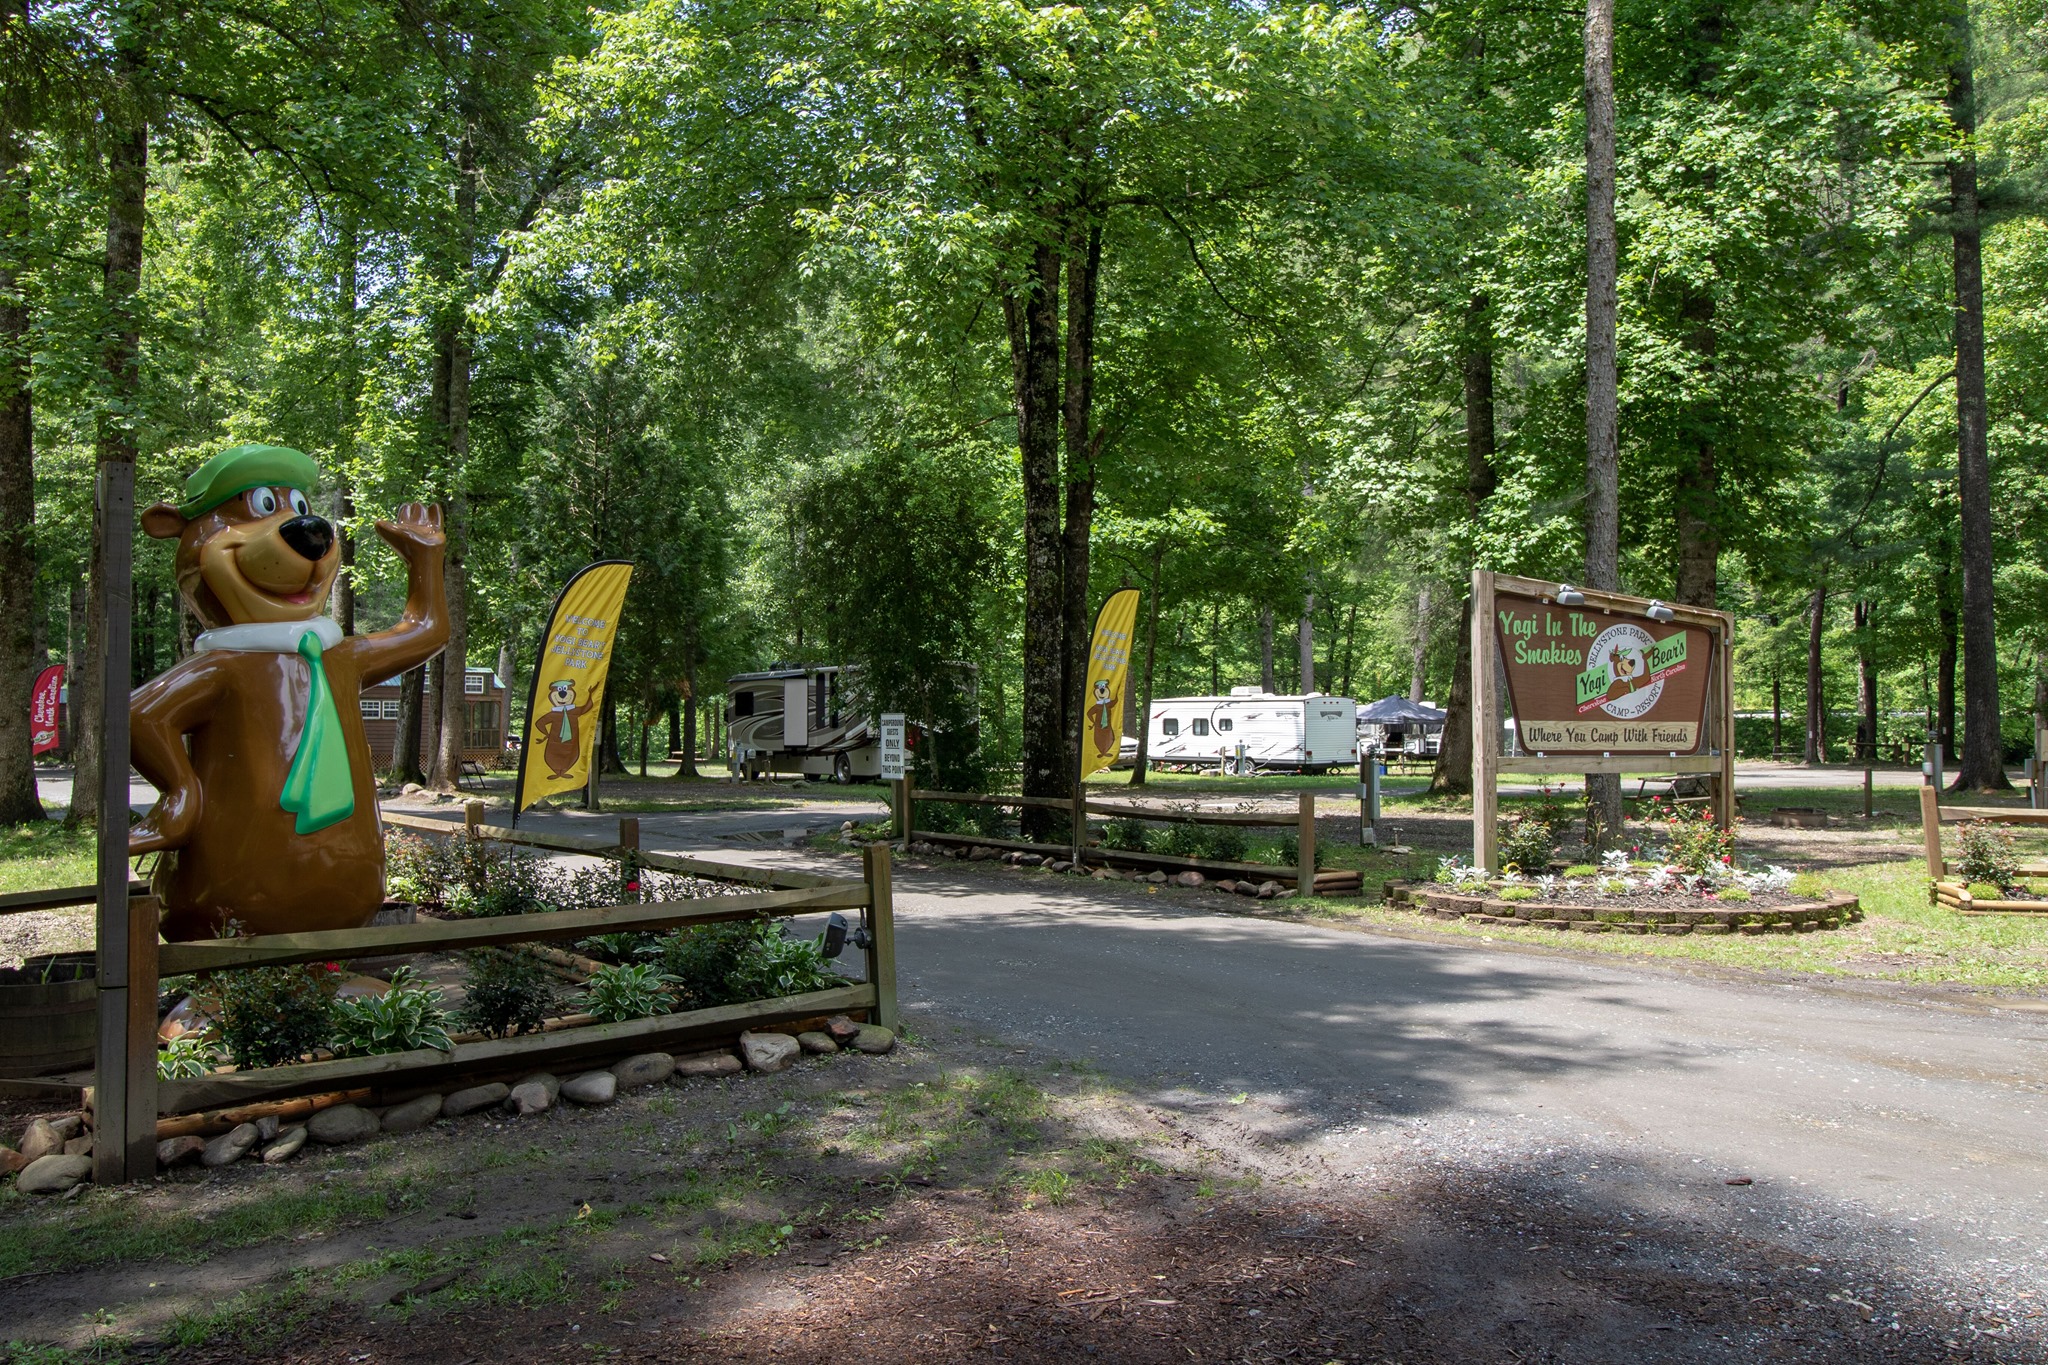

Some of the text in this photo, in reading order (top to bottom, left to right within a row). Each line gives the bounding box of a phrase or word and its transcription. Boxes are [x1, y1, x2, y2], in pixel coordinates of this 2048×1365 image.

[565, 614, 606, 629] WELCOME
[1499, 611, 1597, 640] Yogi In The
[577, 627, 588, 636] TO
[555, 634, 576, 645] YOGI
[1589, 626, 1628, 668] JELLYSTONE
[551, 645, 604, 660] JELLYSTONE
[1514, 640, 1582, 665] Smokies
[564, 657, 587, 669] PARK
[1580, 639, 1685, 695] Yogi Bear's
[885, 739, 900, 748] ONLY
[1529, 728, 1687, 745] Where You Camp With Friends
[884, 754, 900, 762] BEYOND
[882, 765, 904, 774] THIS POINT
